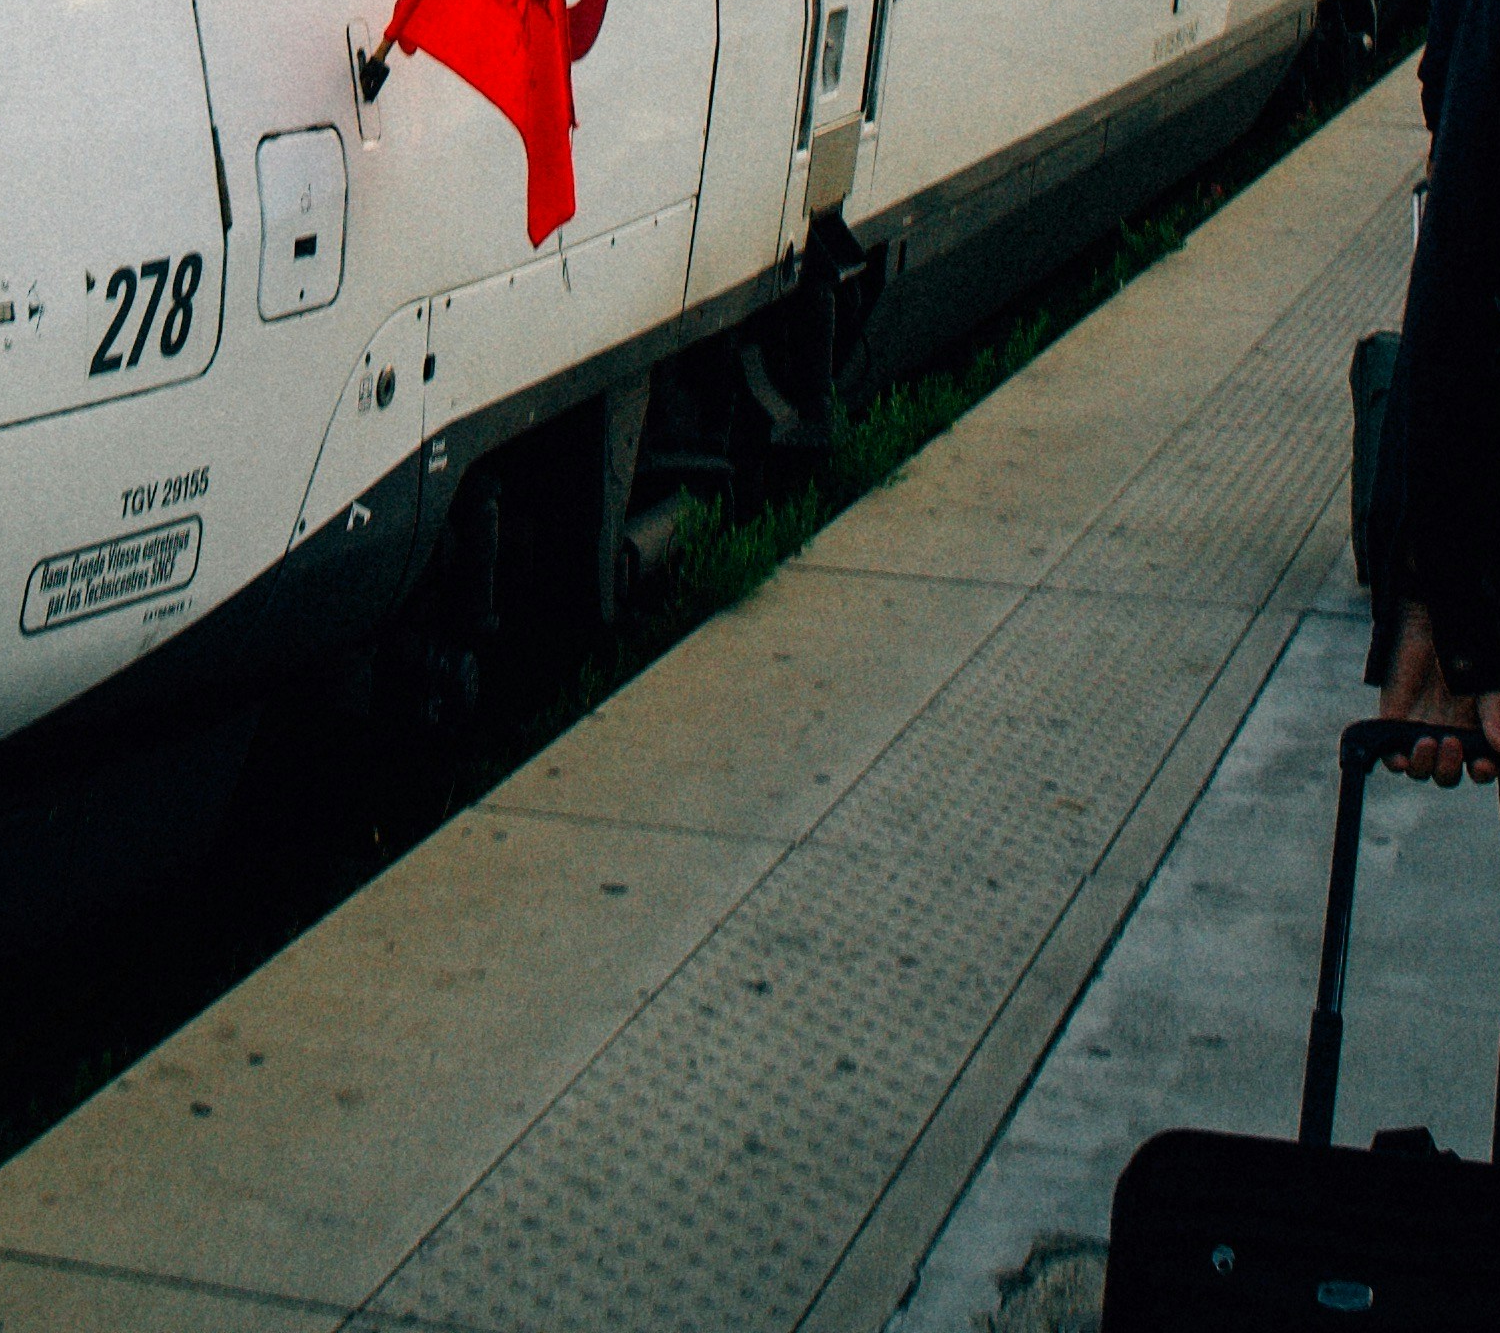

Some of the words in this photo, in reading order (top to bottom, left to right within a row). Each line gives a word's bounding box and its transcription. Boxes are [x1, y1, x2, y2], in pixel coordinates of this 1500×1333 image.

[88, 250, 203, 379] 278
[121, 480, 159, 519] TGV
[161, 464, 210, 508] 29155
